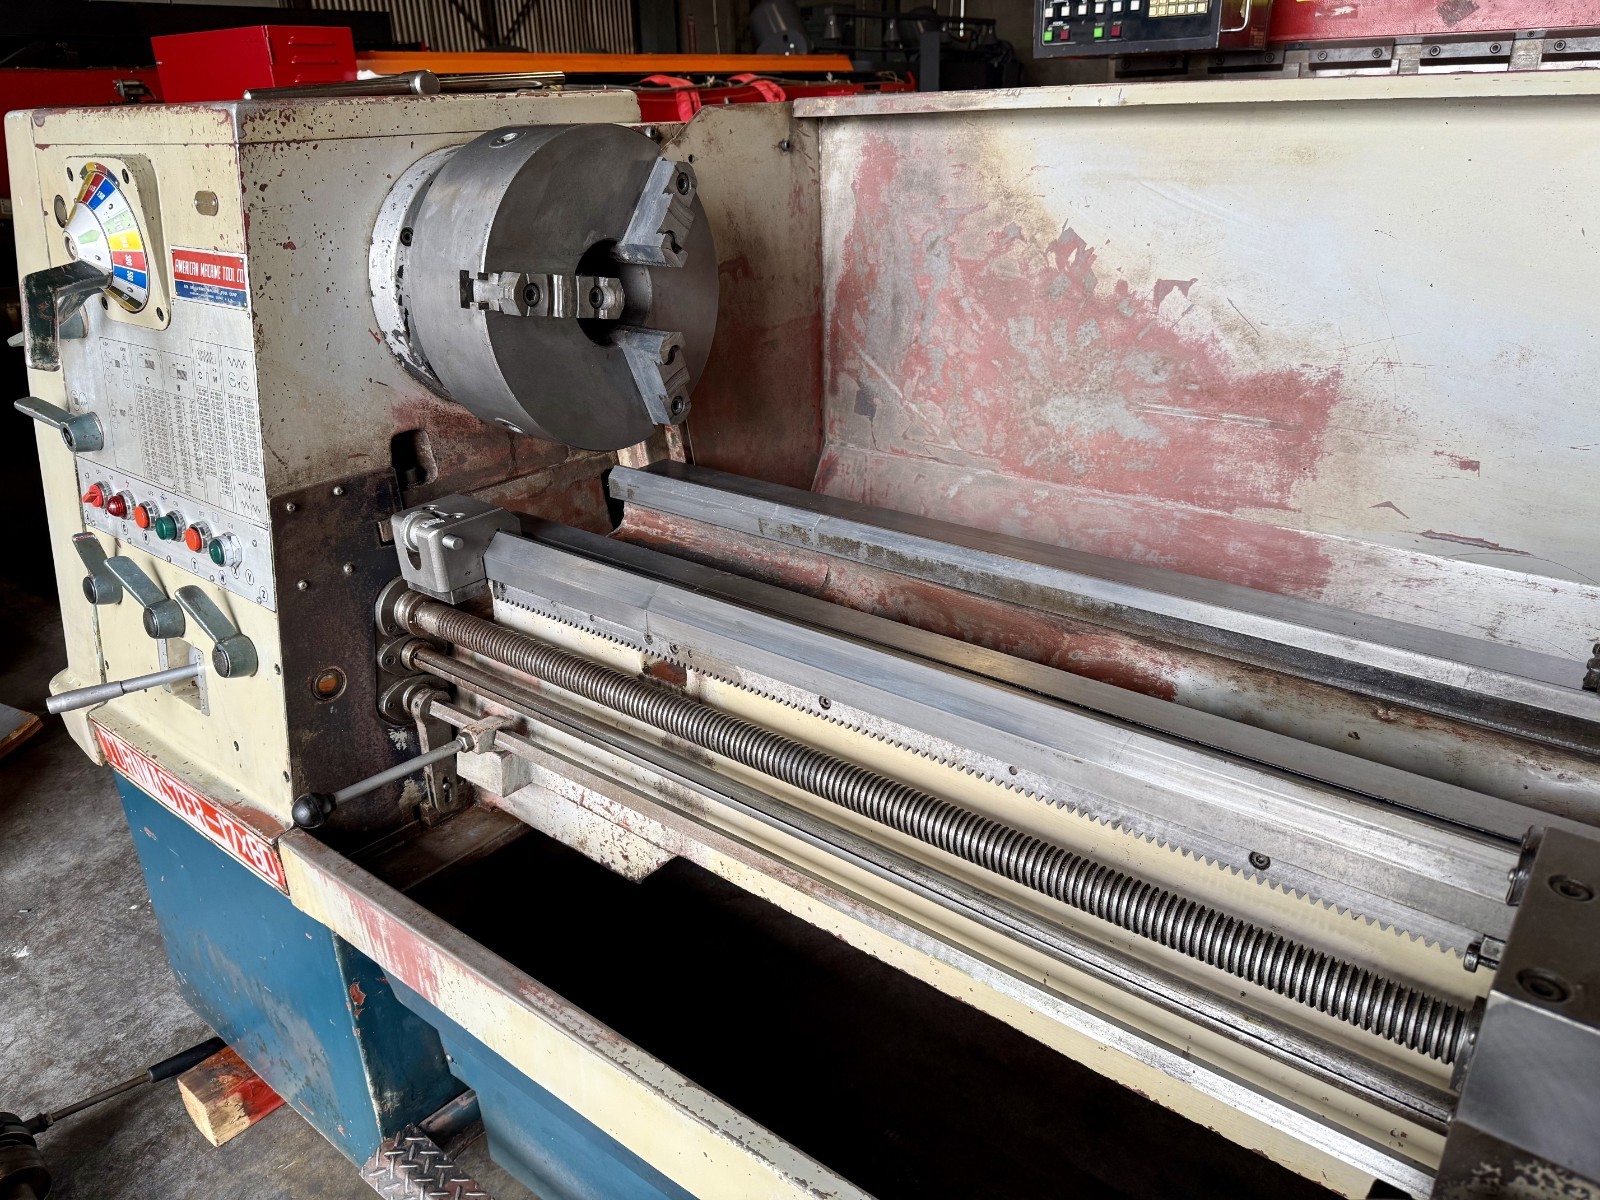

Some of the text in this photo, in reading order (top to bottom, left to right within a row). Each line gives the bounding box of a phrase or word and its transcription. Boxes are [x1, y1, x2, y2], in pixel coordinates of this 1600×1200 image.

[175, 259, 245, 284] AMERICAN MACHINE TOOL CO.
